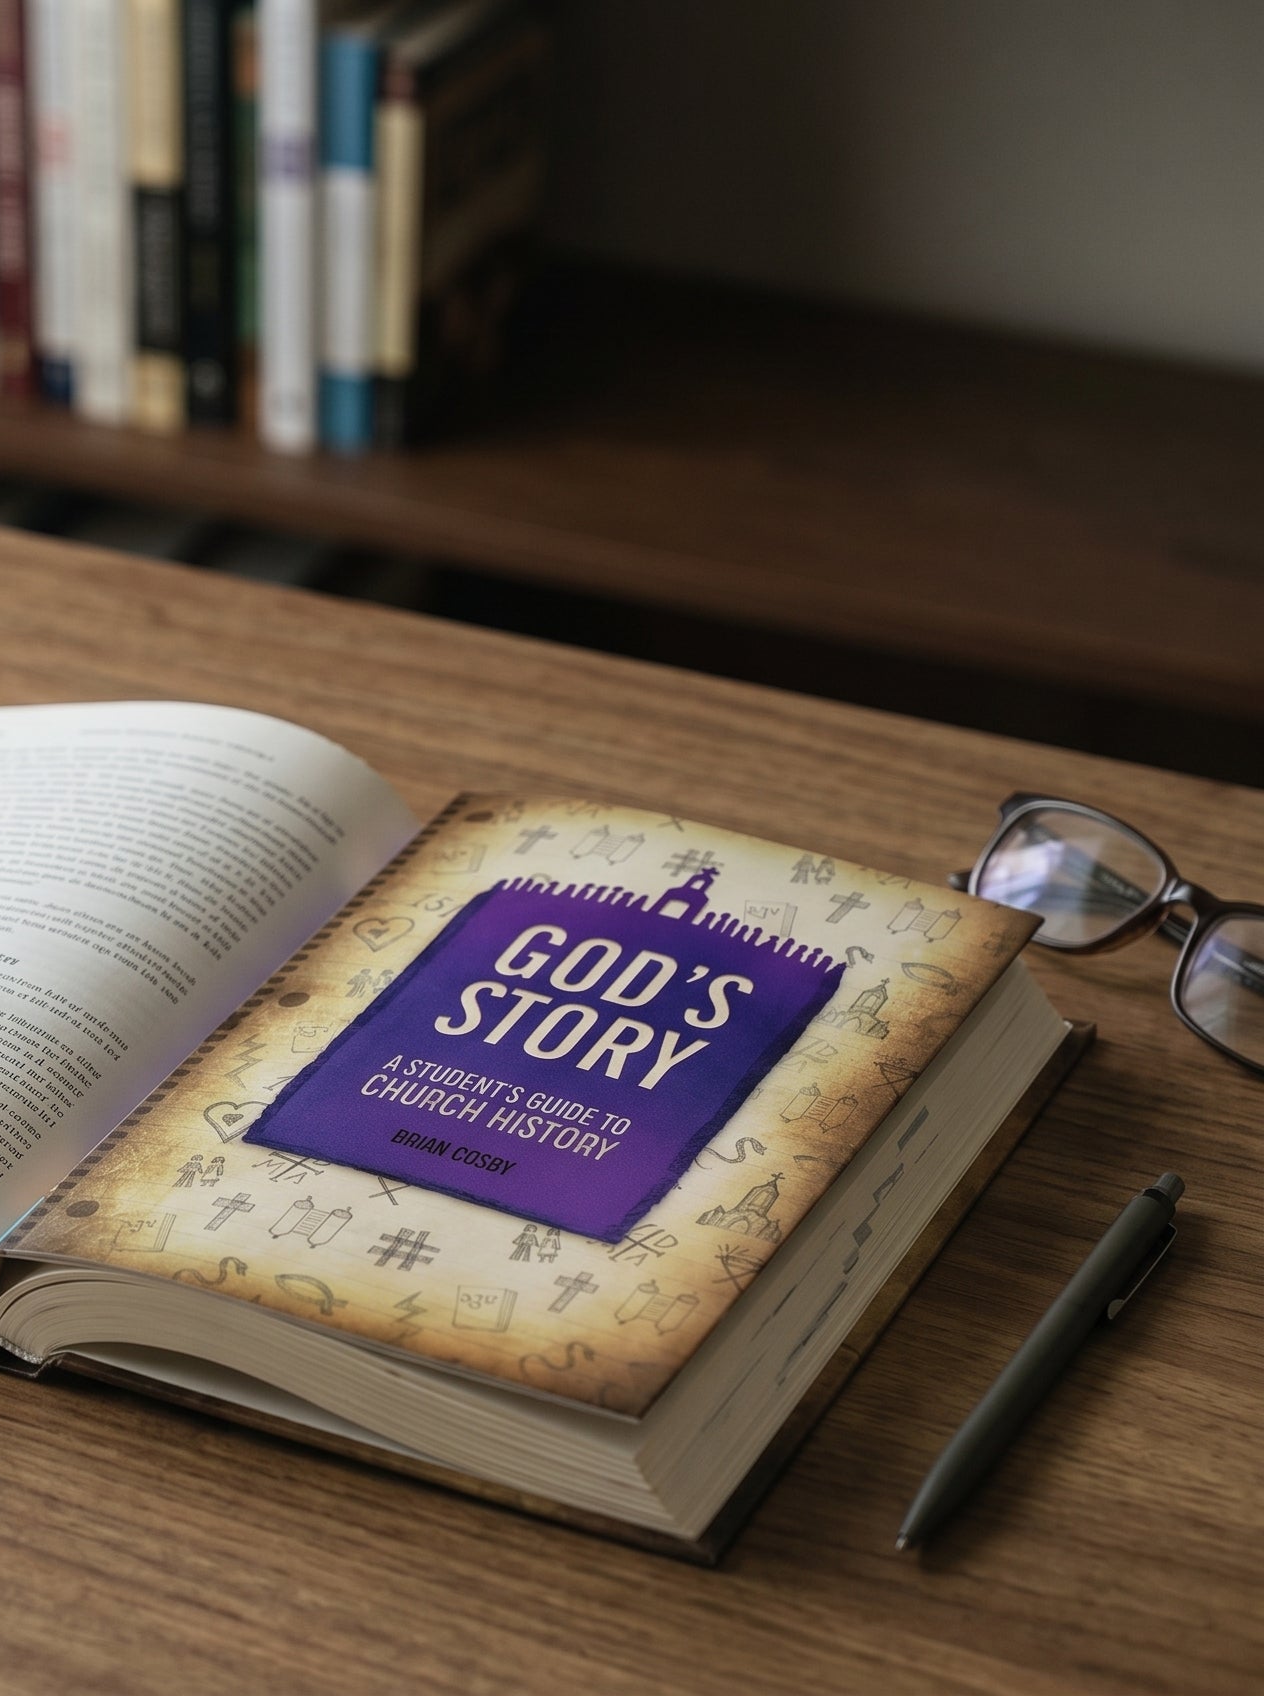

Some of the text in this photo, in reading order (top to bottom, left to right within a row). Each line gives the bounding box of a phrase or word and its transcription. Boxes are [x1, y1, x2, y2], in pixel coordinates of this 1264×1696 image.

[494, 924, 754, 1029] GOD'S
[434, 981, 710, 1090] STORY
[360, 1073, 621, 1161] CHURCH HISTORY
[382, 1054, 632, 1136] A STUDENT'S GUIDE TO
[390, 1128, 517, 1176] BRIAN COSBY
